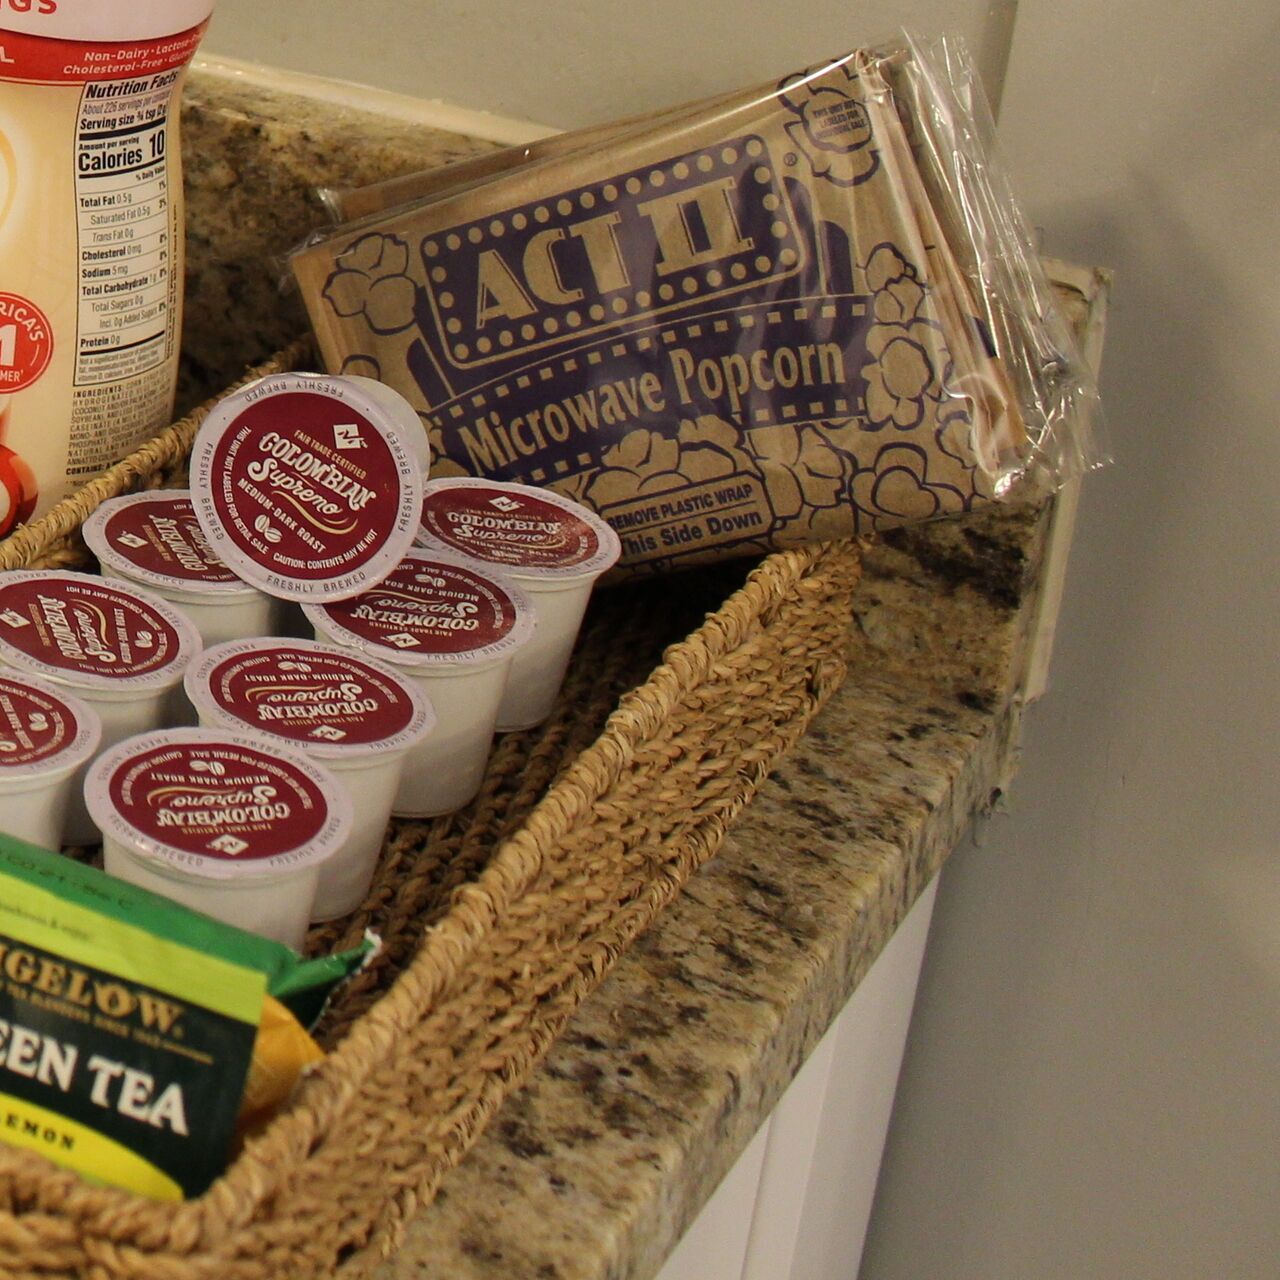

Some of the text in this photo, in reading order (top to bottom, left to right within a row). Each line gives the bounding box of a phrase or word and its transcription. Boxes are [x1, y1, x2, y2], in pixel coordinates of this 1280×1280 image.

[84, 48, 149, 62] Non-Dairy
[63, 59, 162, 74] Cholesterol-Free
[86, 71, 178, 98] Nutrition Facts
[82, 103, 103, 115] About
[104, 101, 118, 114] 226
[118, 98, 142, 112] servings
[80, 114, 134, 130] Serving size
[78, 137, 139, 151] Amount per serving
[79, 130, 165, 171] Calories 10
[80, 195, 101, 208] Total
[103, 194, 116, 205] Fat
[91, 206, 150, 225] Saturated Fat 0.5g
[93, 230, 124, 242] Trans Fat
[82, 247, 126, 261] Cholesterol
[476, 176, 755, 329] ACT II
[82, 269, 111, 278] Sodium
[82, 276, 148, 295] Total Carbohydrate
[92, 298, 134, 312] Total Sugars
[80, 336, 109, 347] Protein
[296, 381, 344, 398] FRESHLY
[456, 341, 846, 479] Microwave Popcorn
[293, 430, 367, 480] FAIR TRADE CERTIFIED
[386, 431, 411, 475] BREWED
[199, 442, 213, 489] FRESHLY
[258, 431, 377, 511] COLOMBIAN
[223, 425, 270, 555] THIS UNIT NOT LABELED FOR RETAIL SALE
[247, 457, 343, 516] Supremo
[237, 478, 327, 554] MEDIUM-DARK ROAST
[398, 484, 413, 532] FRESHLY
[608, 484, 753, 531] REMOVE PLASTIC WRAP
[201, 497, 224, 541] BREWED
[446, 511, 562, 535] COLOMBIAN
[453, 524, 546, 542] Supremo
[659, 522, 703, 549] Side
[709, 510, 763, 536] Down
[273, 528, 378, 570] CAUTION: CONTENTS MAY BE HOT
[421, 566, 440, 574] SALE
[266, 574, 314, 593] FRESHLY
[323, 572, 366, 592] BREWED
[405, 584, 479, 602] MEDIUM-DARK
[349, 605, 479, 631] COLOMBIAN
[373, 599, 478, 618] Supremo
[37, 595, 89, 661] COLOMBIAN
[297, 654, 323, 663] RETAIL
[323, 657, 340, 667] FOR
[243, 673, 355, 682] MEDIUM-DARK ROAST
[266, 683, 362, 703] Supremo
[257, 699, 378, 721] COLOMBIAN
[189, 750, 257, 767] FOR RETAIL SALE
[149, 772, 270, 786] MEDIUM-DARK ROAST
[168, 785, 277, 808] Supremo
[156, 803, 291, 827] COLOMBIAN
[87, 1053, 190, 1137] TEA
